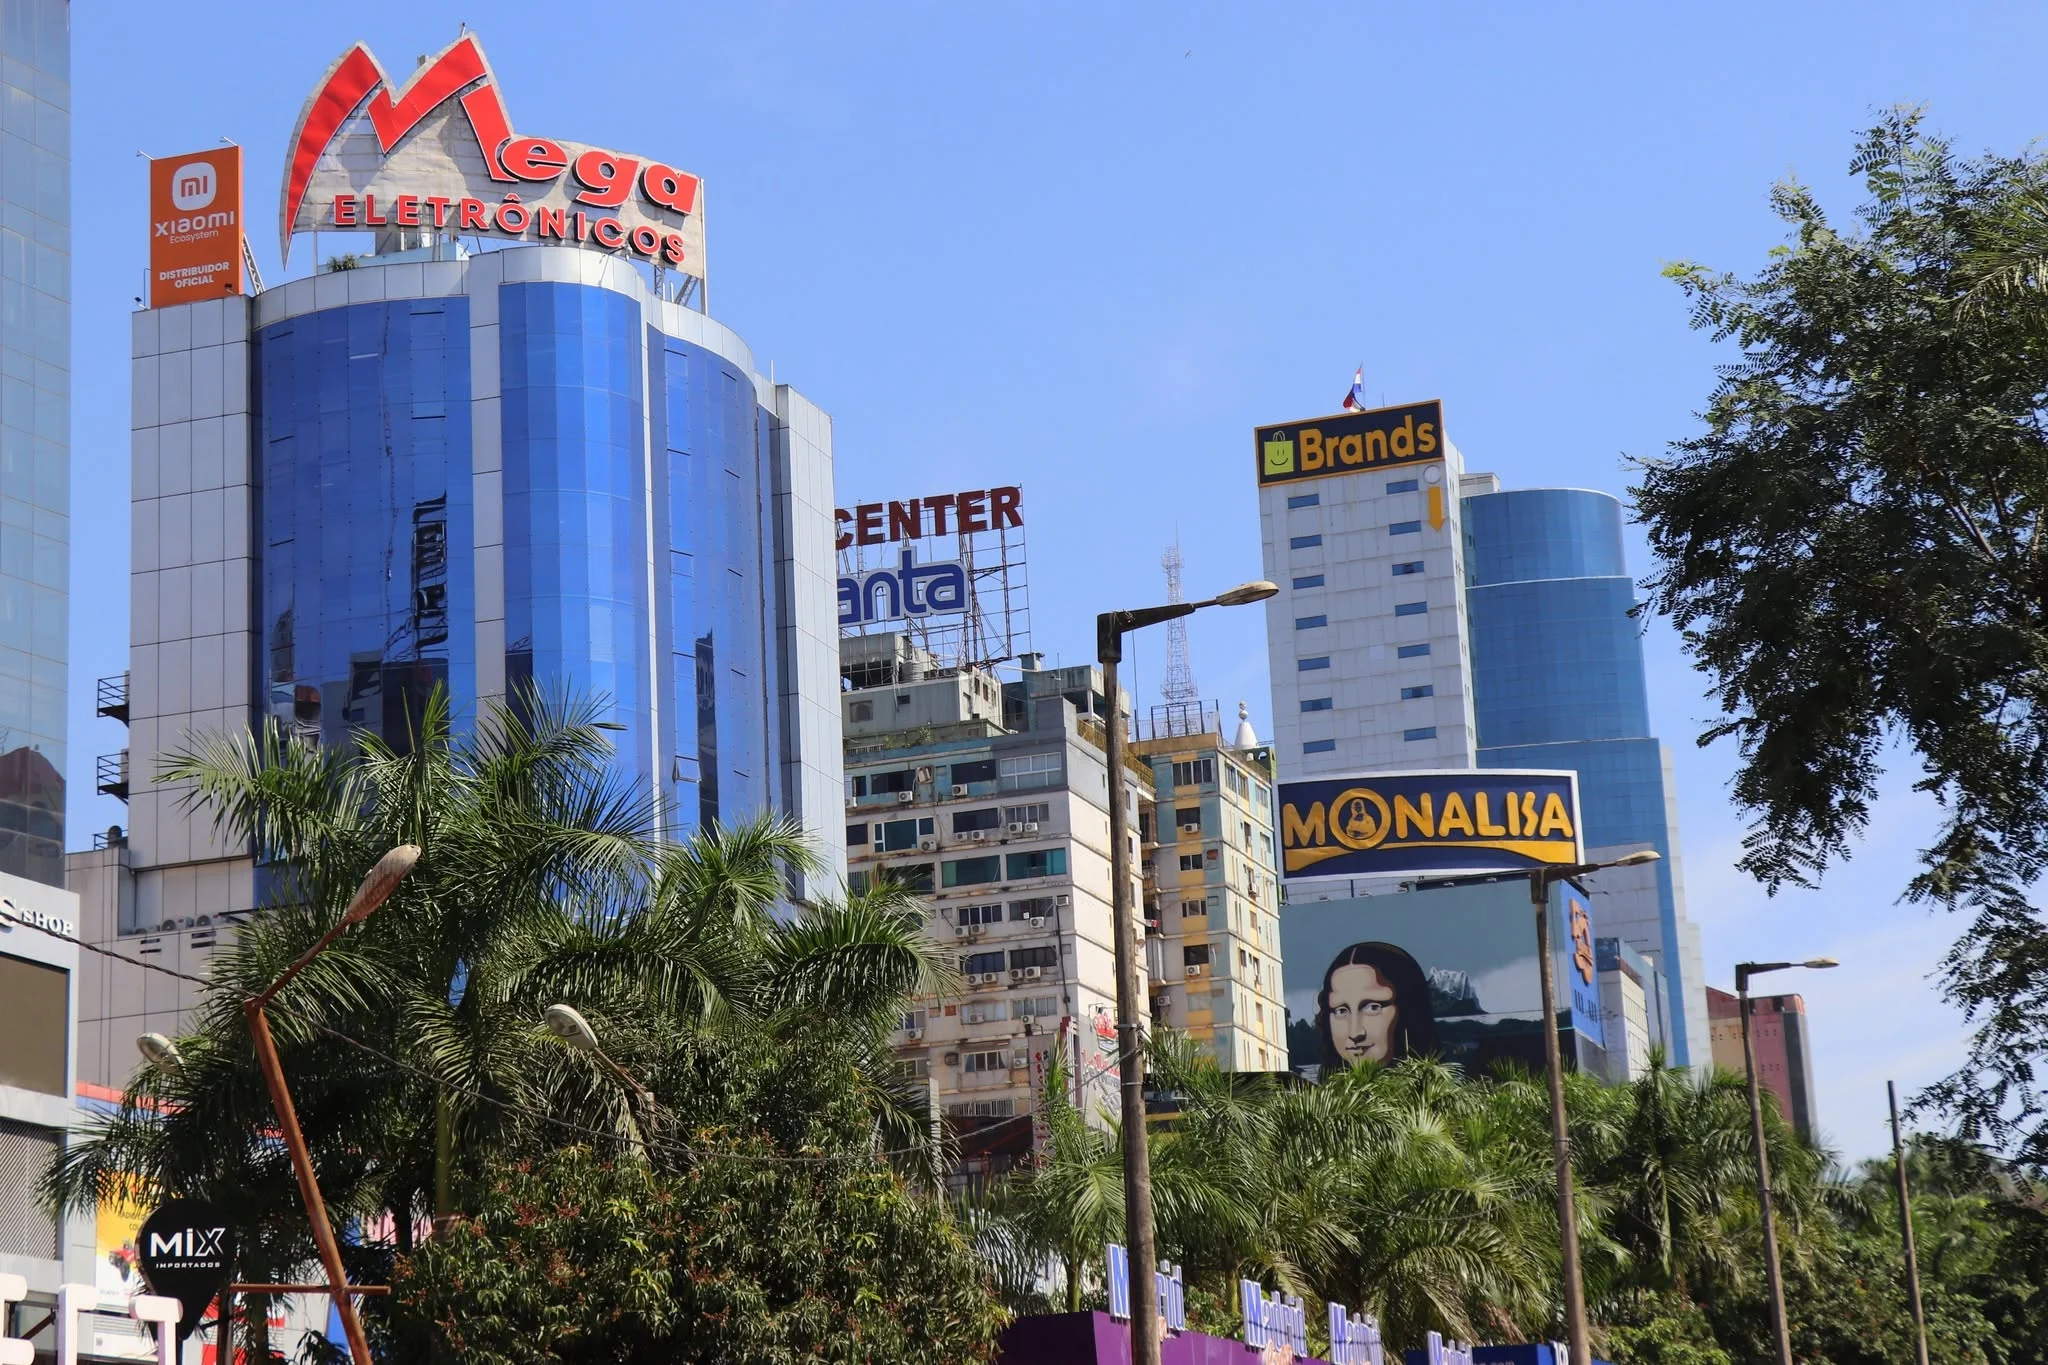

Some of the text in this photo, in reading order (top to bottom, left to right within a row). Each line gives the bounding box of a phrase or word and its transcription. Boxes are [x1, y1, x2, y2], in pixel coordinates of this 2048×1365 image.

[286, 37, 699, 242] Mega
[170, 229, 219, 244] Ecosystem
[334, 193, 686, 264] ELETRÔNICOS
[159, 261, 230, 281] DISTRIBUIDOR
[174, 274, 215, 290] OFICIAL
[1300, 414, 1437, 471] Brands
[835, 486, 1024, 551] CENTER
[1283, 788, 1574, 849] MONALISA
[22, 908, 74, 935] SHOP
[155, 1261, 221, 1269] IMPORTADOS
